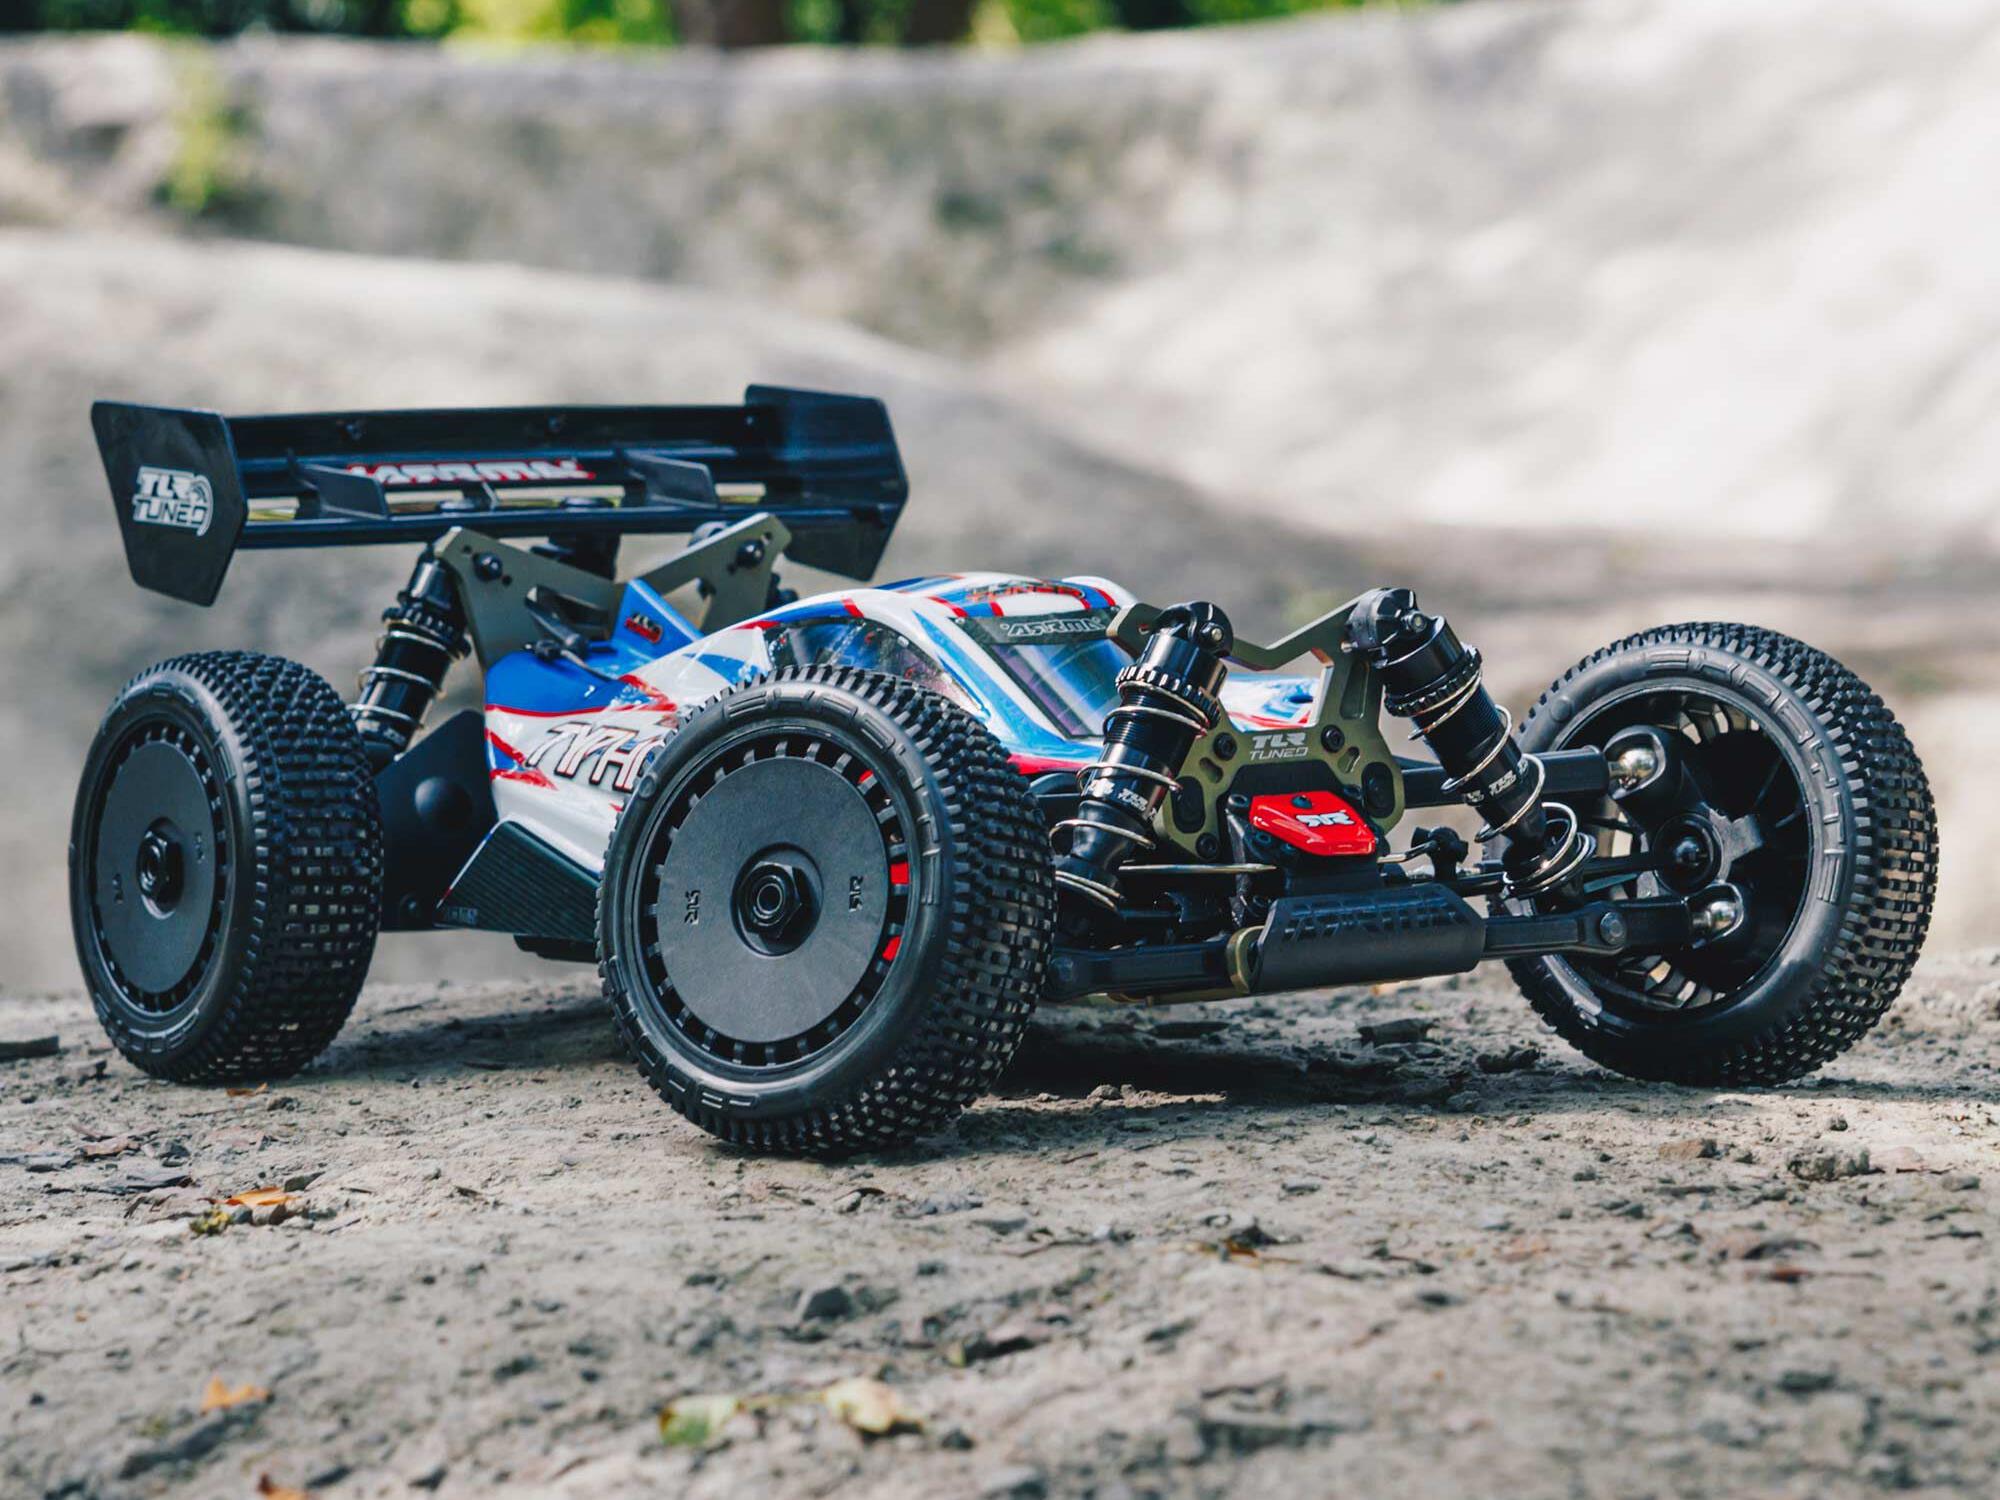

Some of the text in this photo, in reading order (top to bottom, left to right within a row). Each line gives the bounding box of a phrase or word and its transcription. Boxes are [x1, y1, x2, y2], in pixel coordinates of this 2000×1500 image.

[136, 498, 207, 526] TUNED
[1251, 732, 1306, 750] TLR
[525, 720, 668, 794] TYPH
[1249, 746, 1308, 761] TUNED
